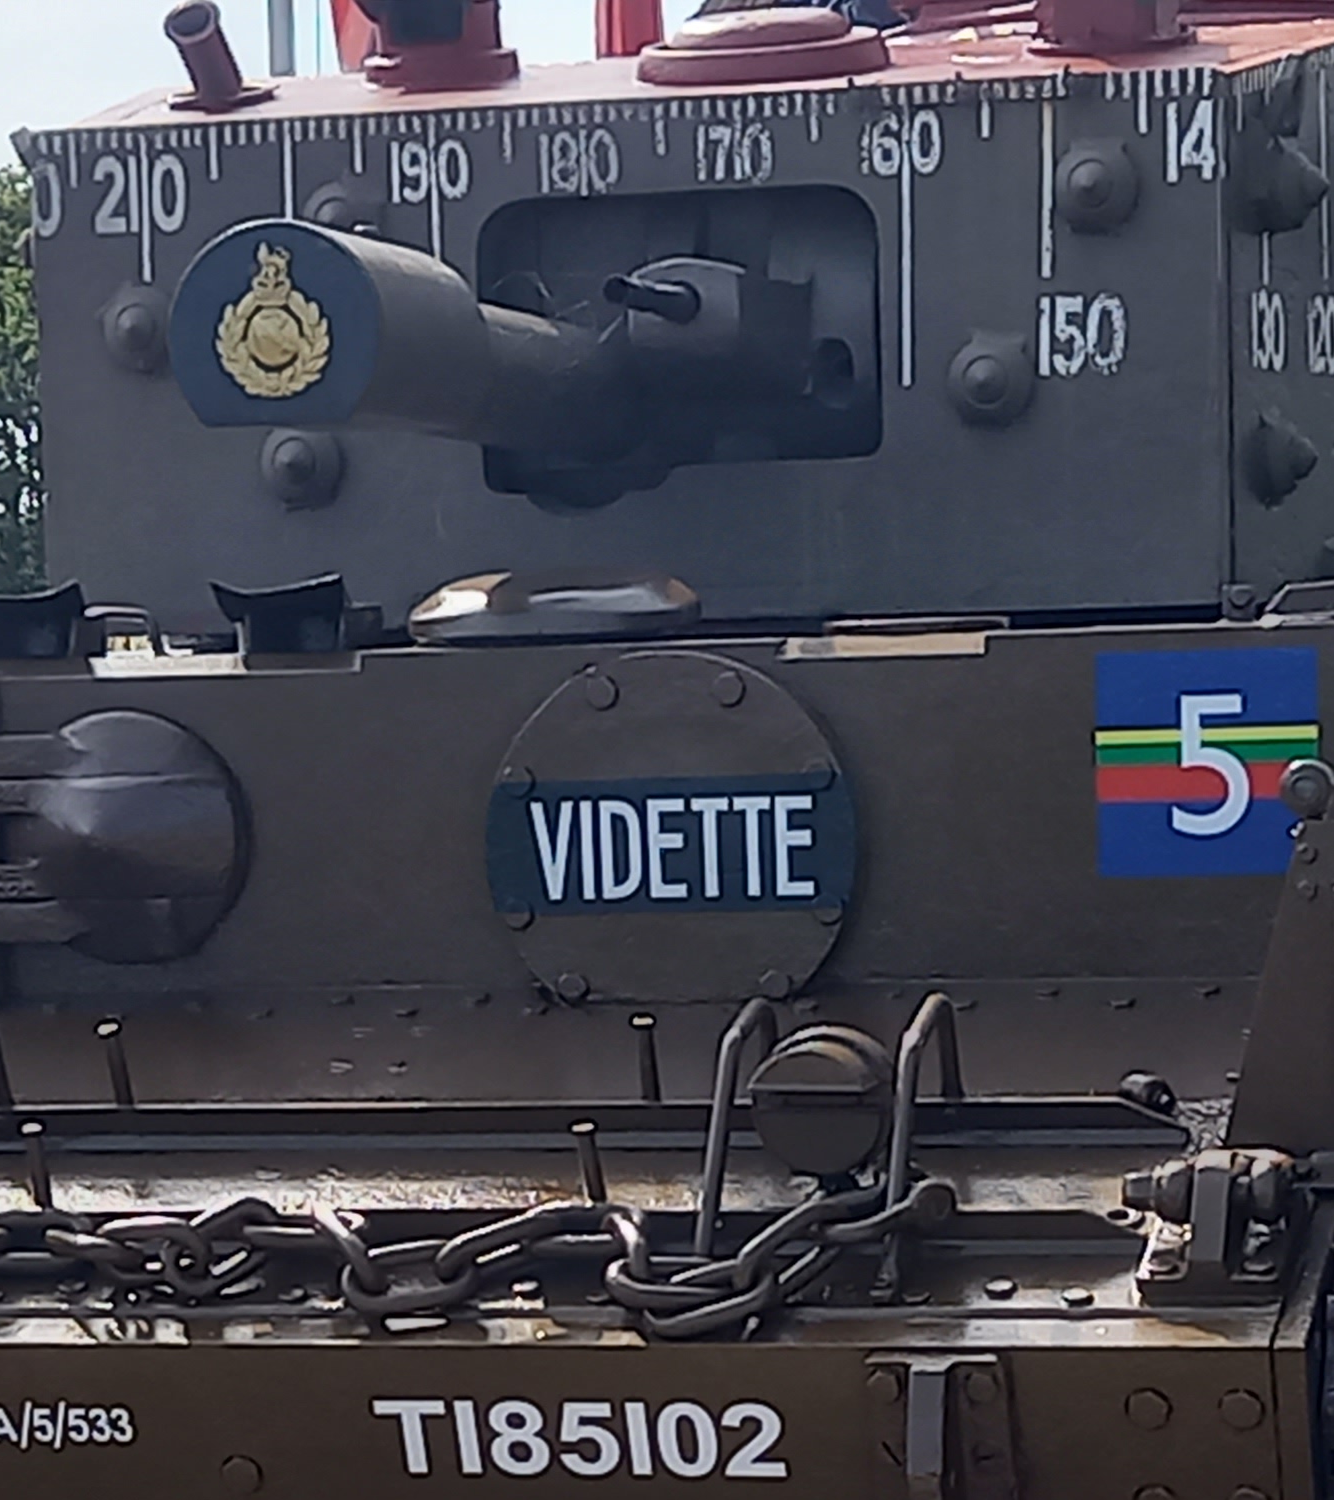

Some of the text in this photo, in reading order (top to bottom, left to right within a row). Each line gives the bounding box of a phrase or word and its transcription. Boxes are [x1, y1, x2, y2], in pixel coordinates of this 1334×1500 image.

[390, 138, 468, 203] 190
[539, 128, 620, 195] 180
[696, 122, 771, 184] 170
[1167, 98, 1226, 183] 14
[93, 153, 186, 235] 210
[1037, 293, 1128, 376] 150
[1252, 288, 1285, 373] 130
[1171, 693, 1250, 836] 5
[530, 795, 816, 901] VIDETTE
